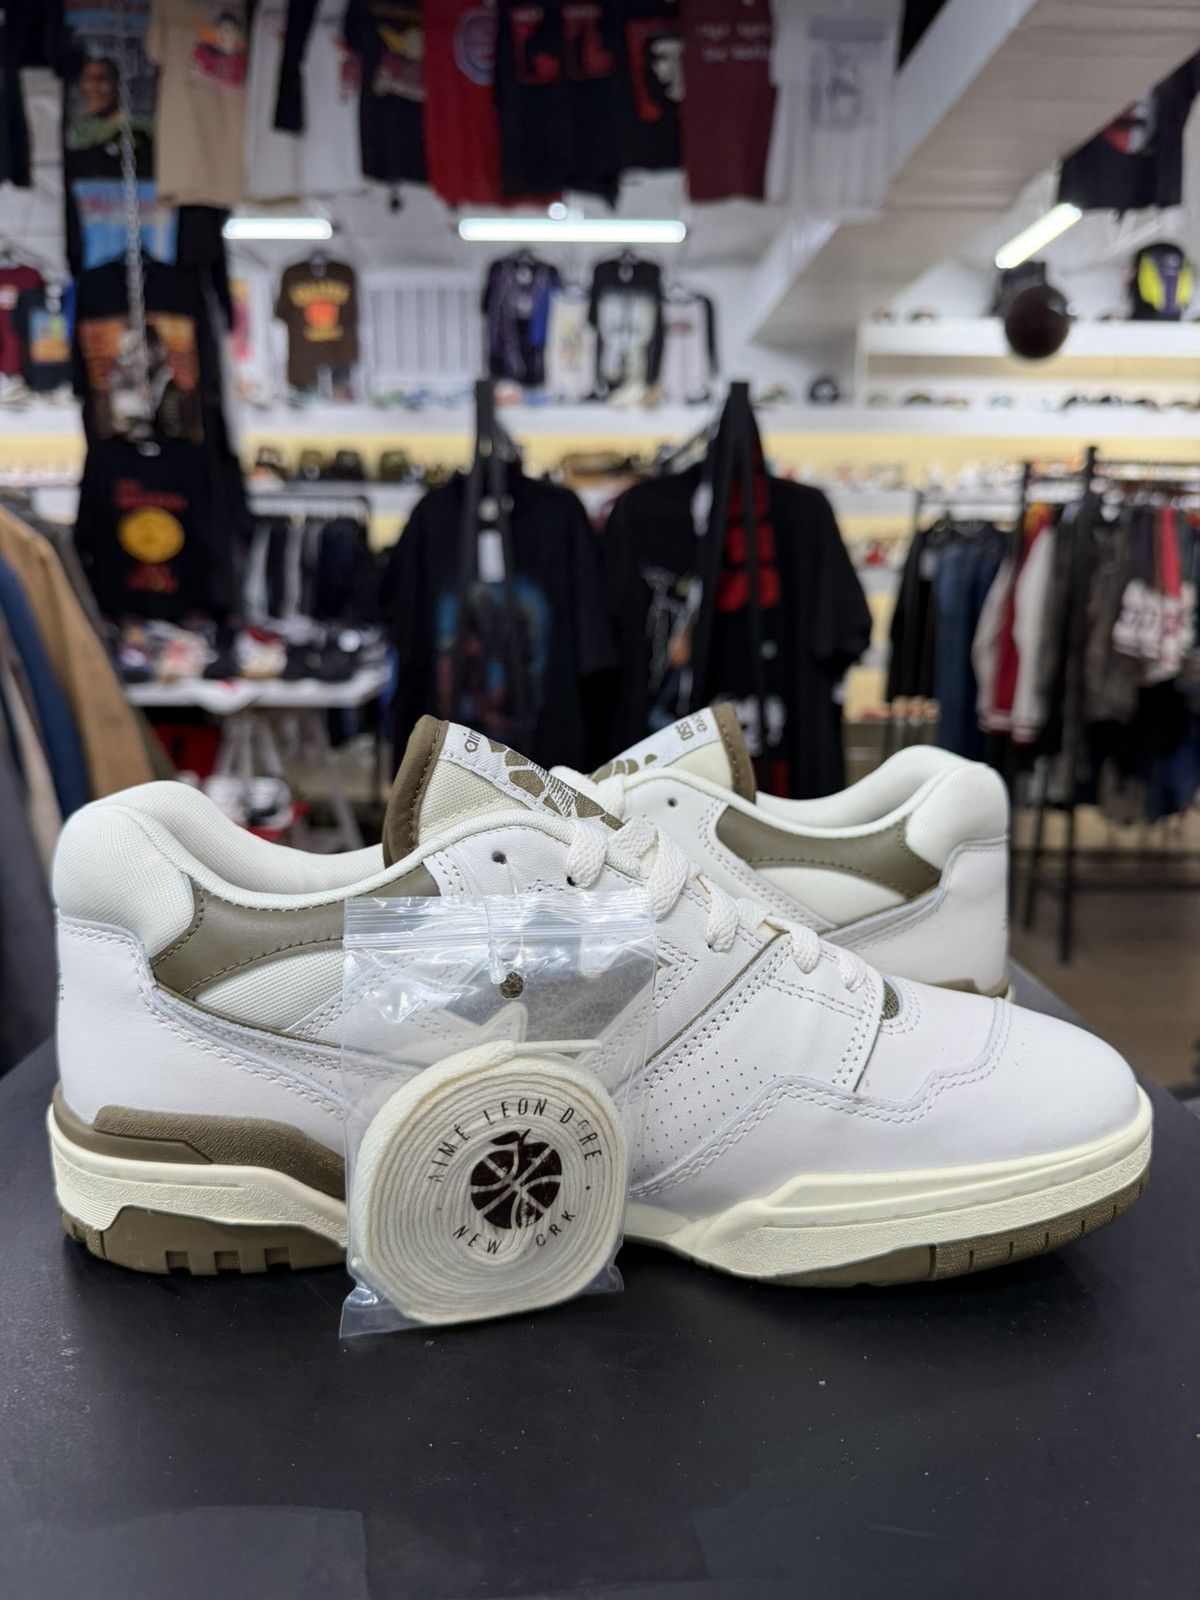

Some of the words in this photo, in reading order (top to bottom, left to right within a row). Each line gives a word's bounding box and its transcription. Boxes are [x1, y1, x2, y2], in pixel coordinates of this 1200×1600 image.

[483, 1097, 548, 1126] LEON
[452, 1224, 503, 1255] NEW
[535, 1210, 577, 1247] ORK
